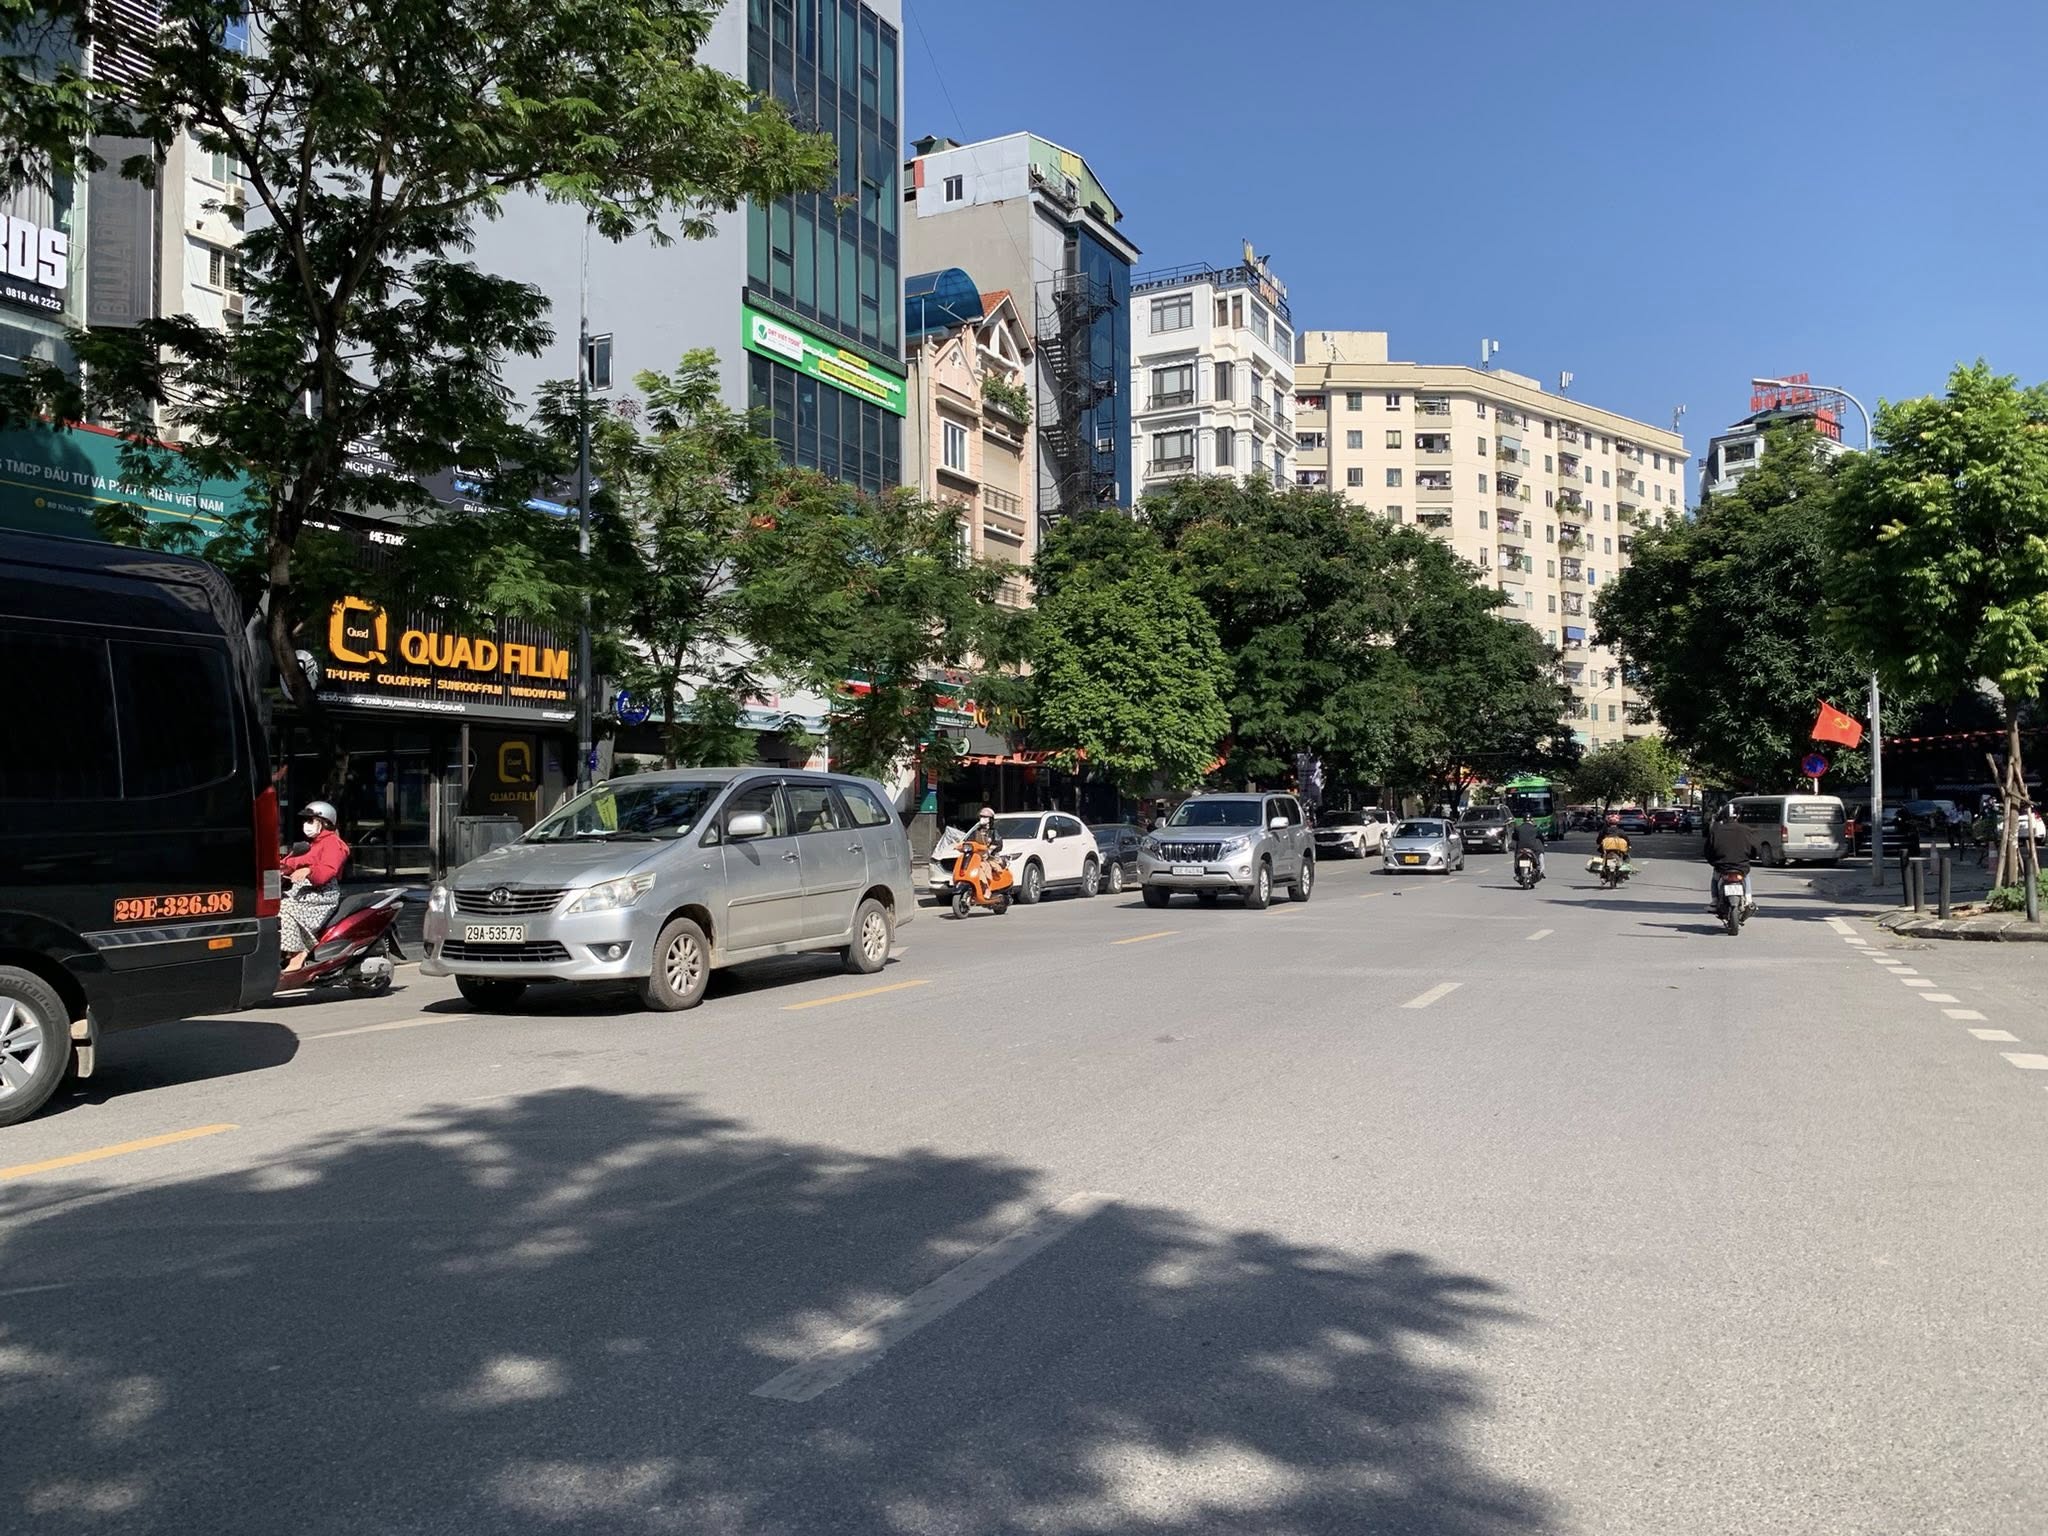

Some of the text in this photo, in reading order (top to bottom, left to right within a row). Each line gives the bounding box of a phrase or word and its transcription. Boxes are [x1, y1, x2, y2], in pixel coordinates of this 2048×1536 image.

[5, 286, 62, 311] 0818 44 2222
[5, 458, 42, 476] TMCP
[200, 498, 224, 513] NAM
[346, 626, 369, 639] Quad
[400, 630, 569, 680] QUAD FILM
[348, 670, 370, 682] PPF
[377, 673, 410, 686] COLOR
[410, 677, 431, 688] PPF
[437, 679, 482, 693] SUNROOF
[481, 684, 503, 695] FILM
[510, 686, 547, 699] WINDOW
[547, 690, 566, 700] FILM
[115, 892, 233, 921] 29E-326.98
[467, 926, 522, 941] 29A-535.73
